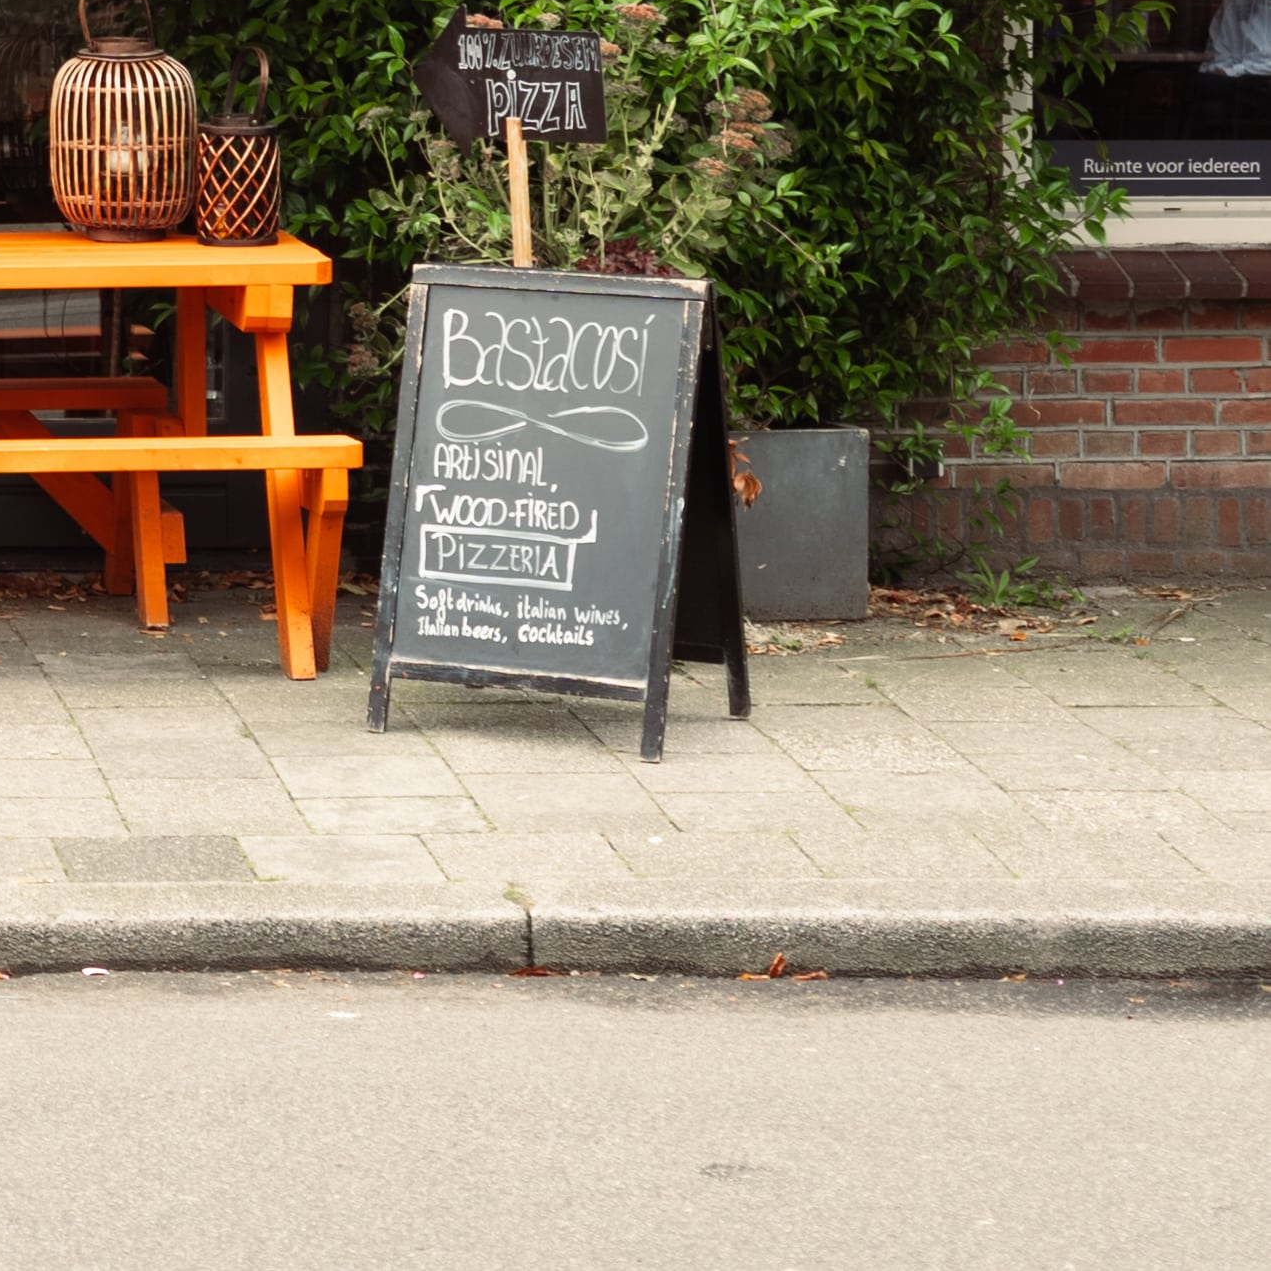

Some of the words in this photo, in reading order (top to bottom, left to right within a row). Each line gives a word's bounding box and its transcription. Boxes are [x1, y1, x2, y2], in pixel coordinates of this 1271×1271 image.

[1084, 158, 1143, 173] Ruimte
[1146, 161, 1184, 173] voor
[1188, 158, 1260, 173] iedereen
